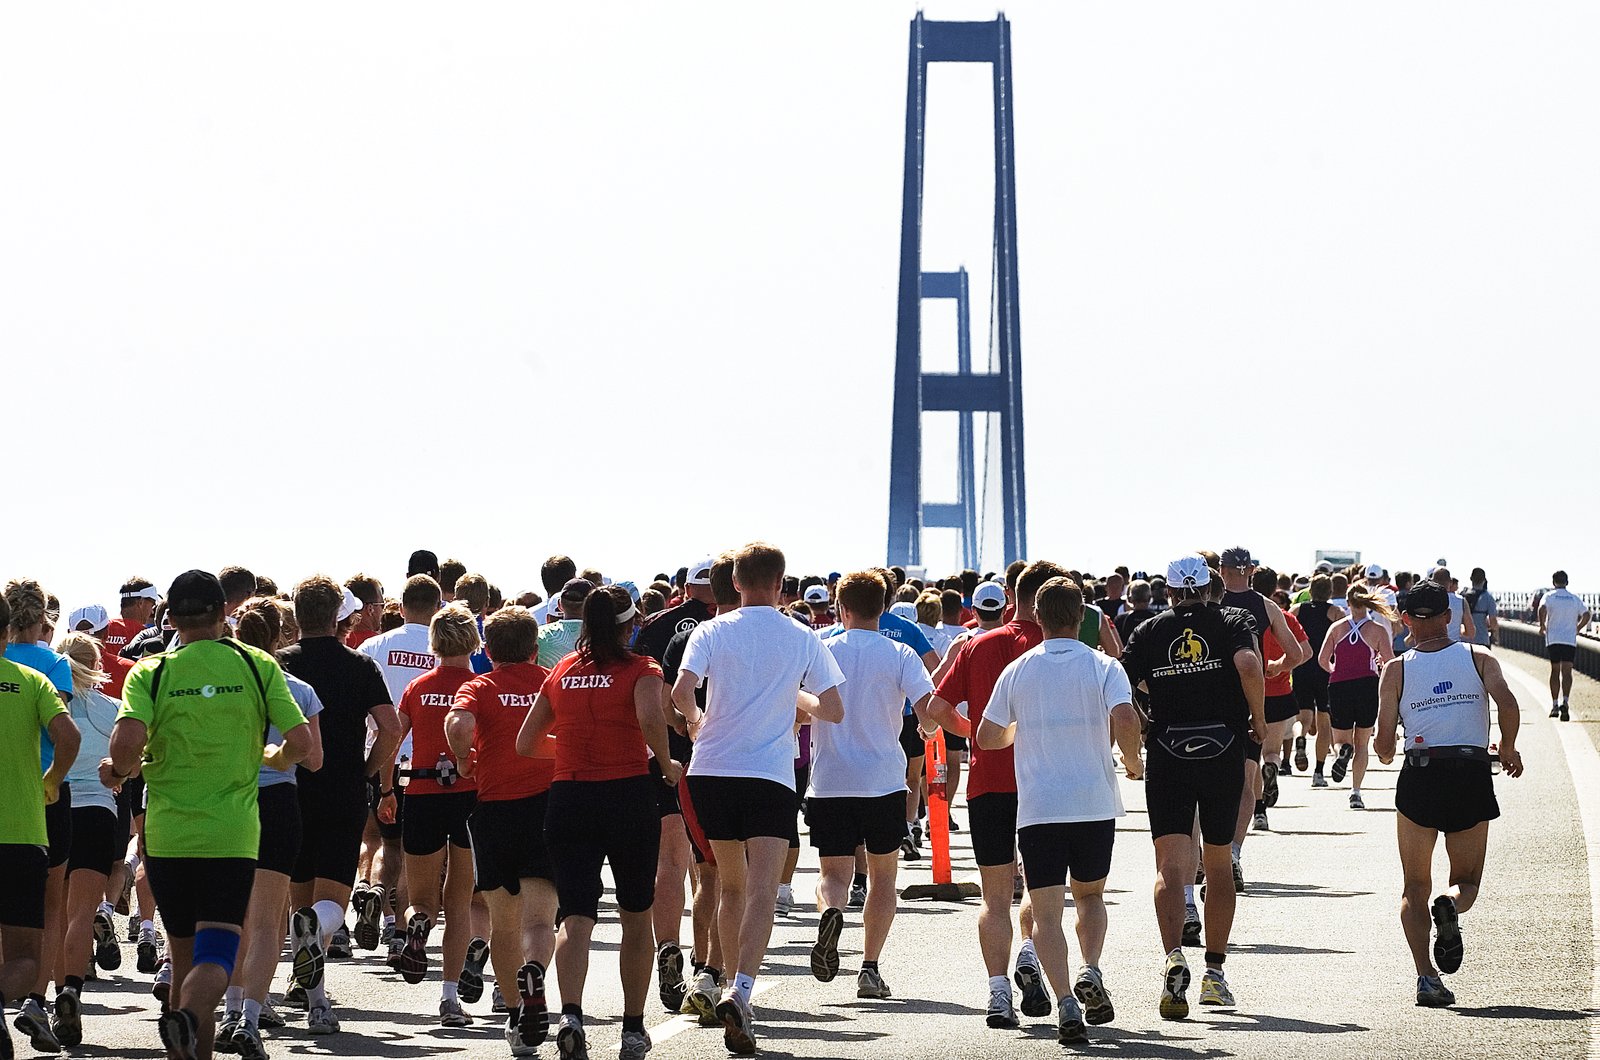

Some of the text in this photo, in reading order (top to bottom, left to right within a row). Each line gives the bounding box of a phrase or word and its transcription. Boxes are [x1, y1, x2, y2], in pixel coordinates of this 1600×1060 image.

[106, 636, 127, 645] LUX
[390, 651, 434, 669] VELUX
[561, 675, 613, 690] VELUX
[420, 693, 456, 707] VELU
[498, 692, 540, 707] VELU
[1410, 696, 1446, 710] Davidsen
[1447, 693, 1480, 702] Partnere
